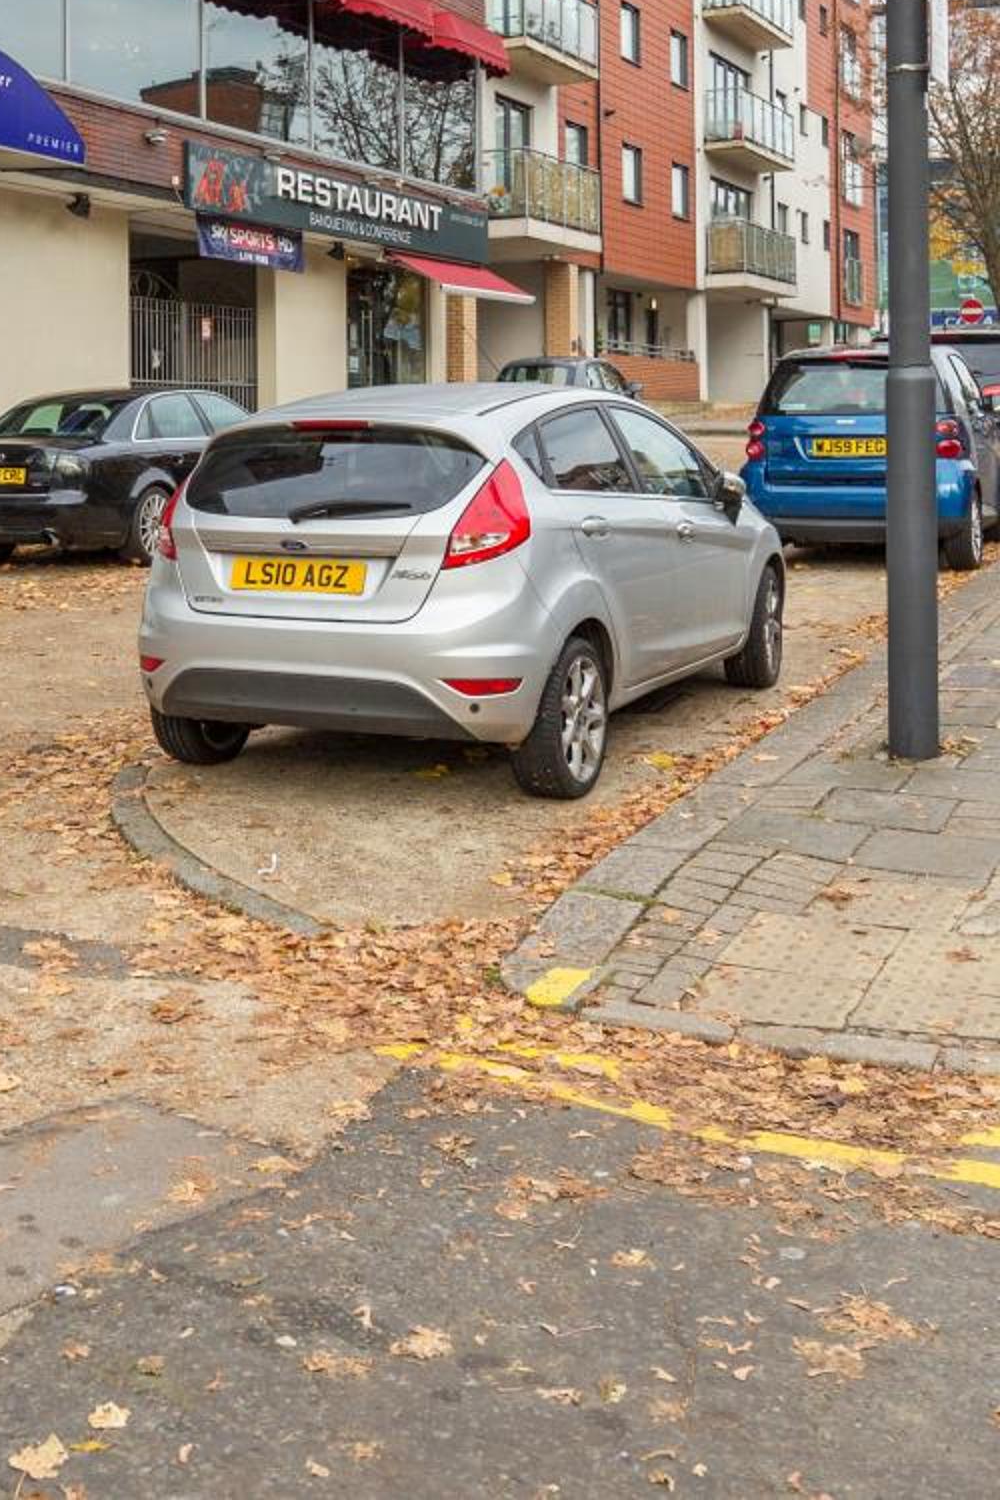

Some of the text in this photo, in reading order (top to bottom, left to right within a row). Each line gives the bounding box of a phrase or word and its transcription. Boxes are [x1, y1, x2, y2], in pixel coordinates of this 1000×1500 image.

[26, 132, 80, 154] PREMIER
[276, 165, 443, 231] RESTAURANT
[229, 227, 275, 251] SPORTS
[243, 561, 350, 588] LS10 AGZ
